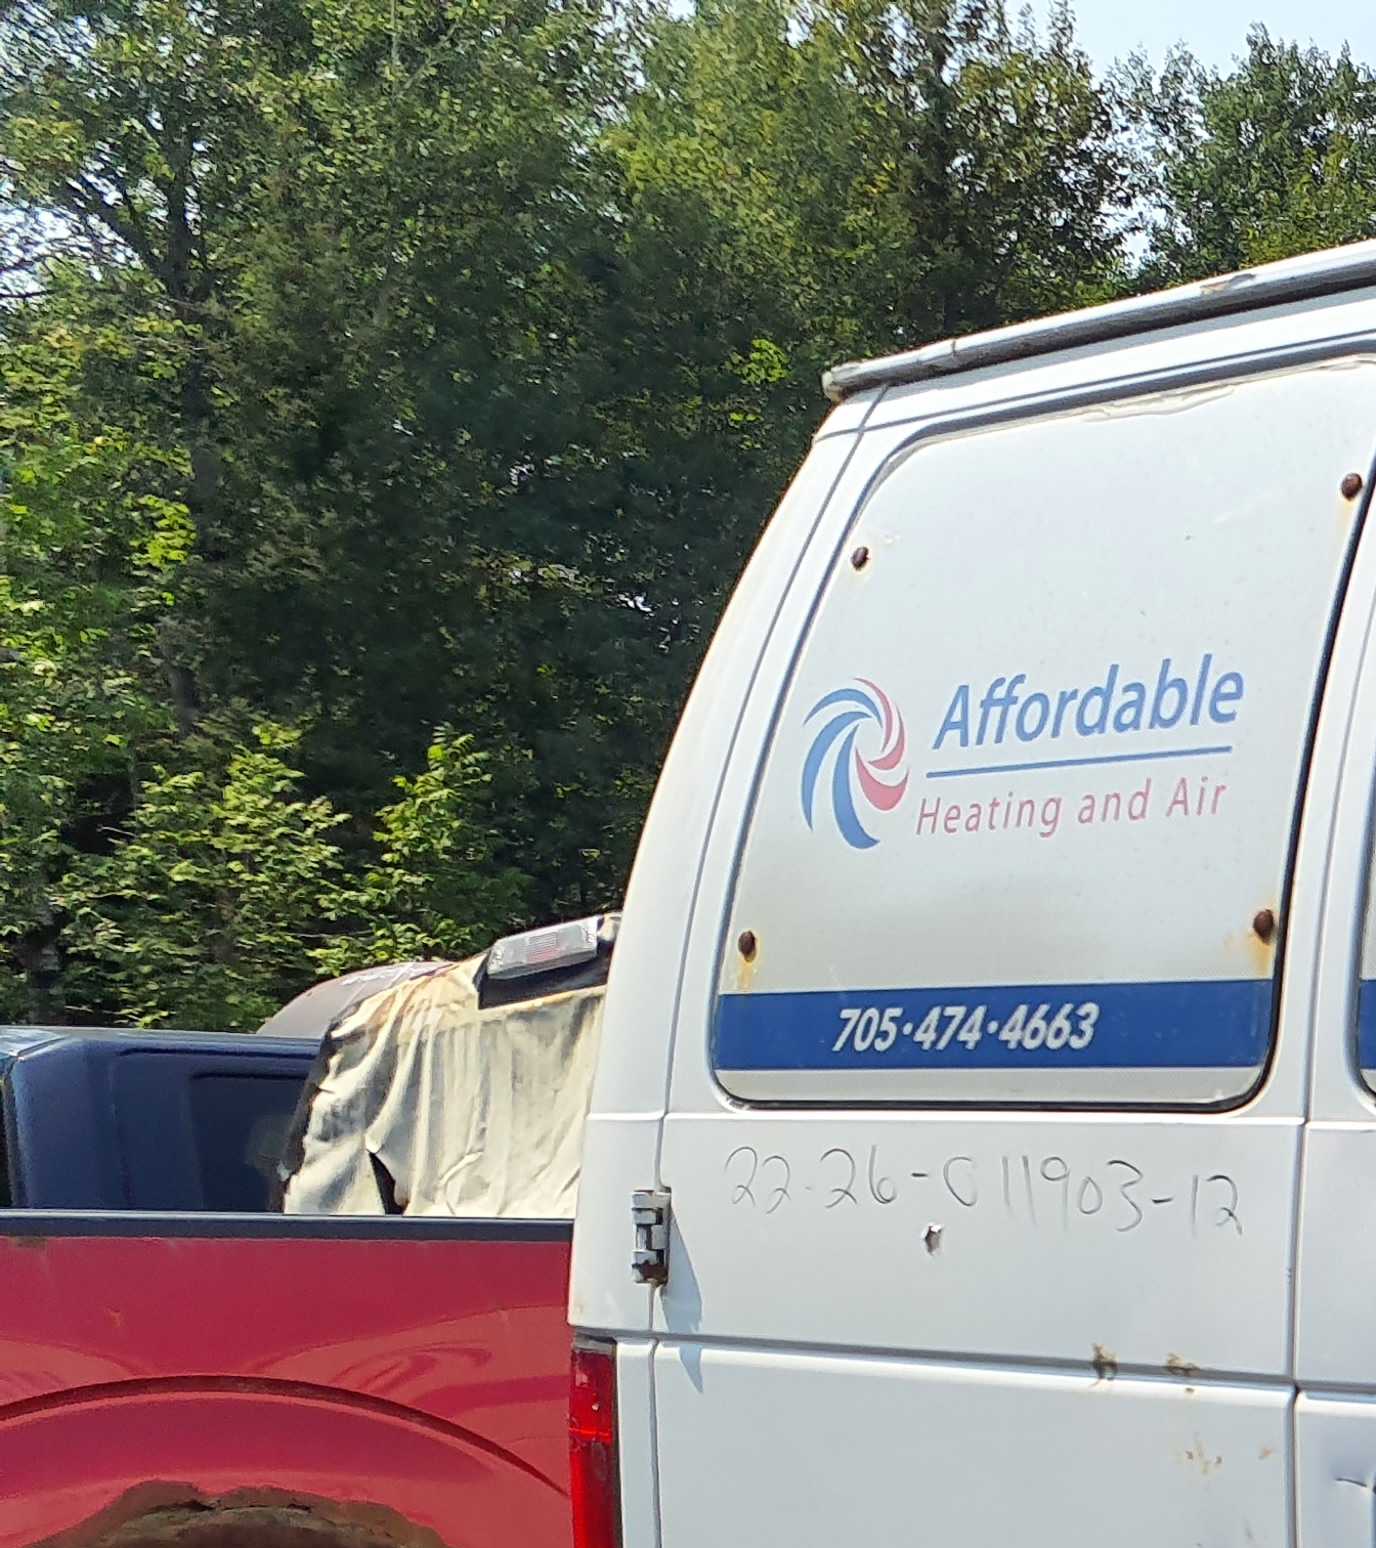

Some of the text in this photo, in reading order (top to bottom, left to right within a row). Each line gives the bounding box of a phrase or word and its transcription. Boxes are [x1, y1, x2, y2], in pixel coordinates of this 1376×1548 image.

[931, 653, 1244, 751] Affordable
[914, 774, 1228, 838] Heating and Air
